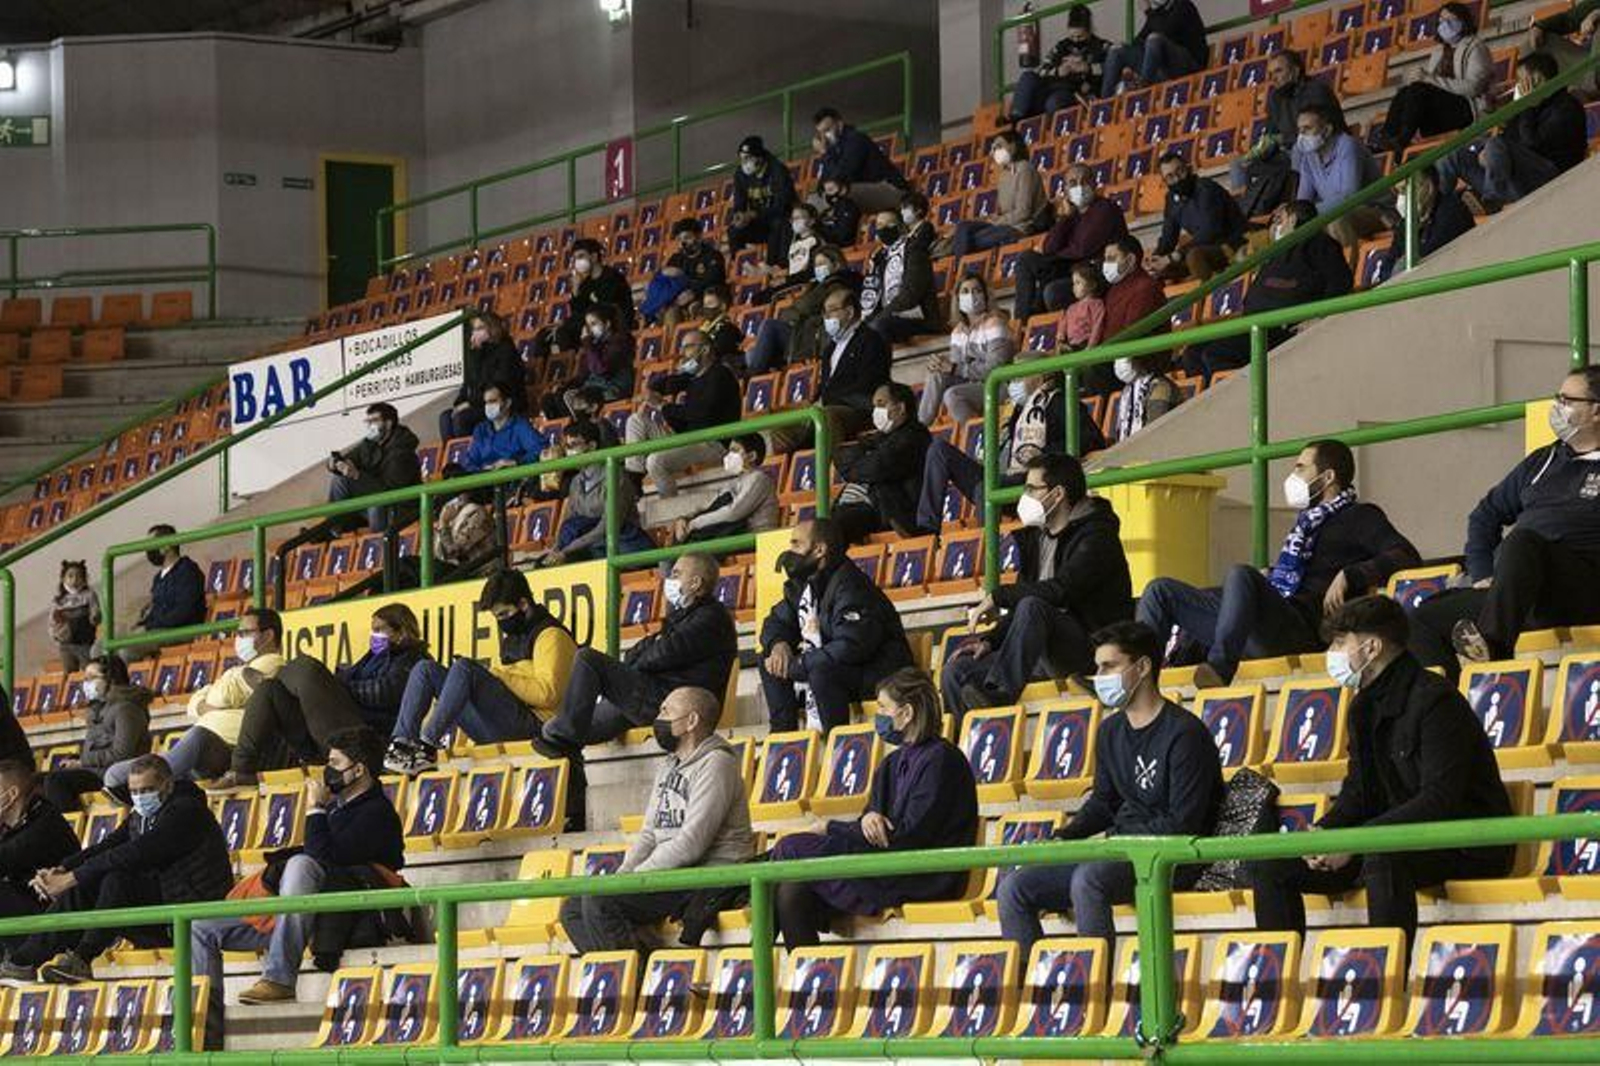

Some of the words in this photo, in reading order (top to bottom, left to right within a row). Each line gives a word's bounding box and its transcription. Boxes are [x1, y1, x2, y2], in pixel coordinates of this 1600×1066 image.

[233, 357, 316, 424] BAR
[356, 376, 401, 398] PERRITOS
[405, 362, 462, 387] HAMBURGUESAS
[286, 621, 352, 668] ISTA
